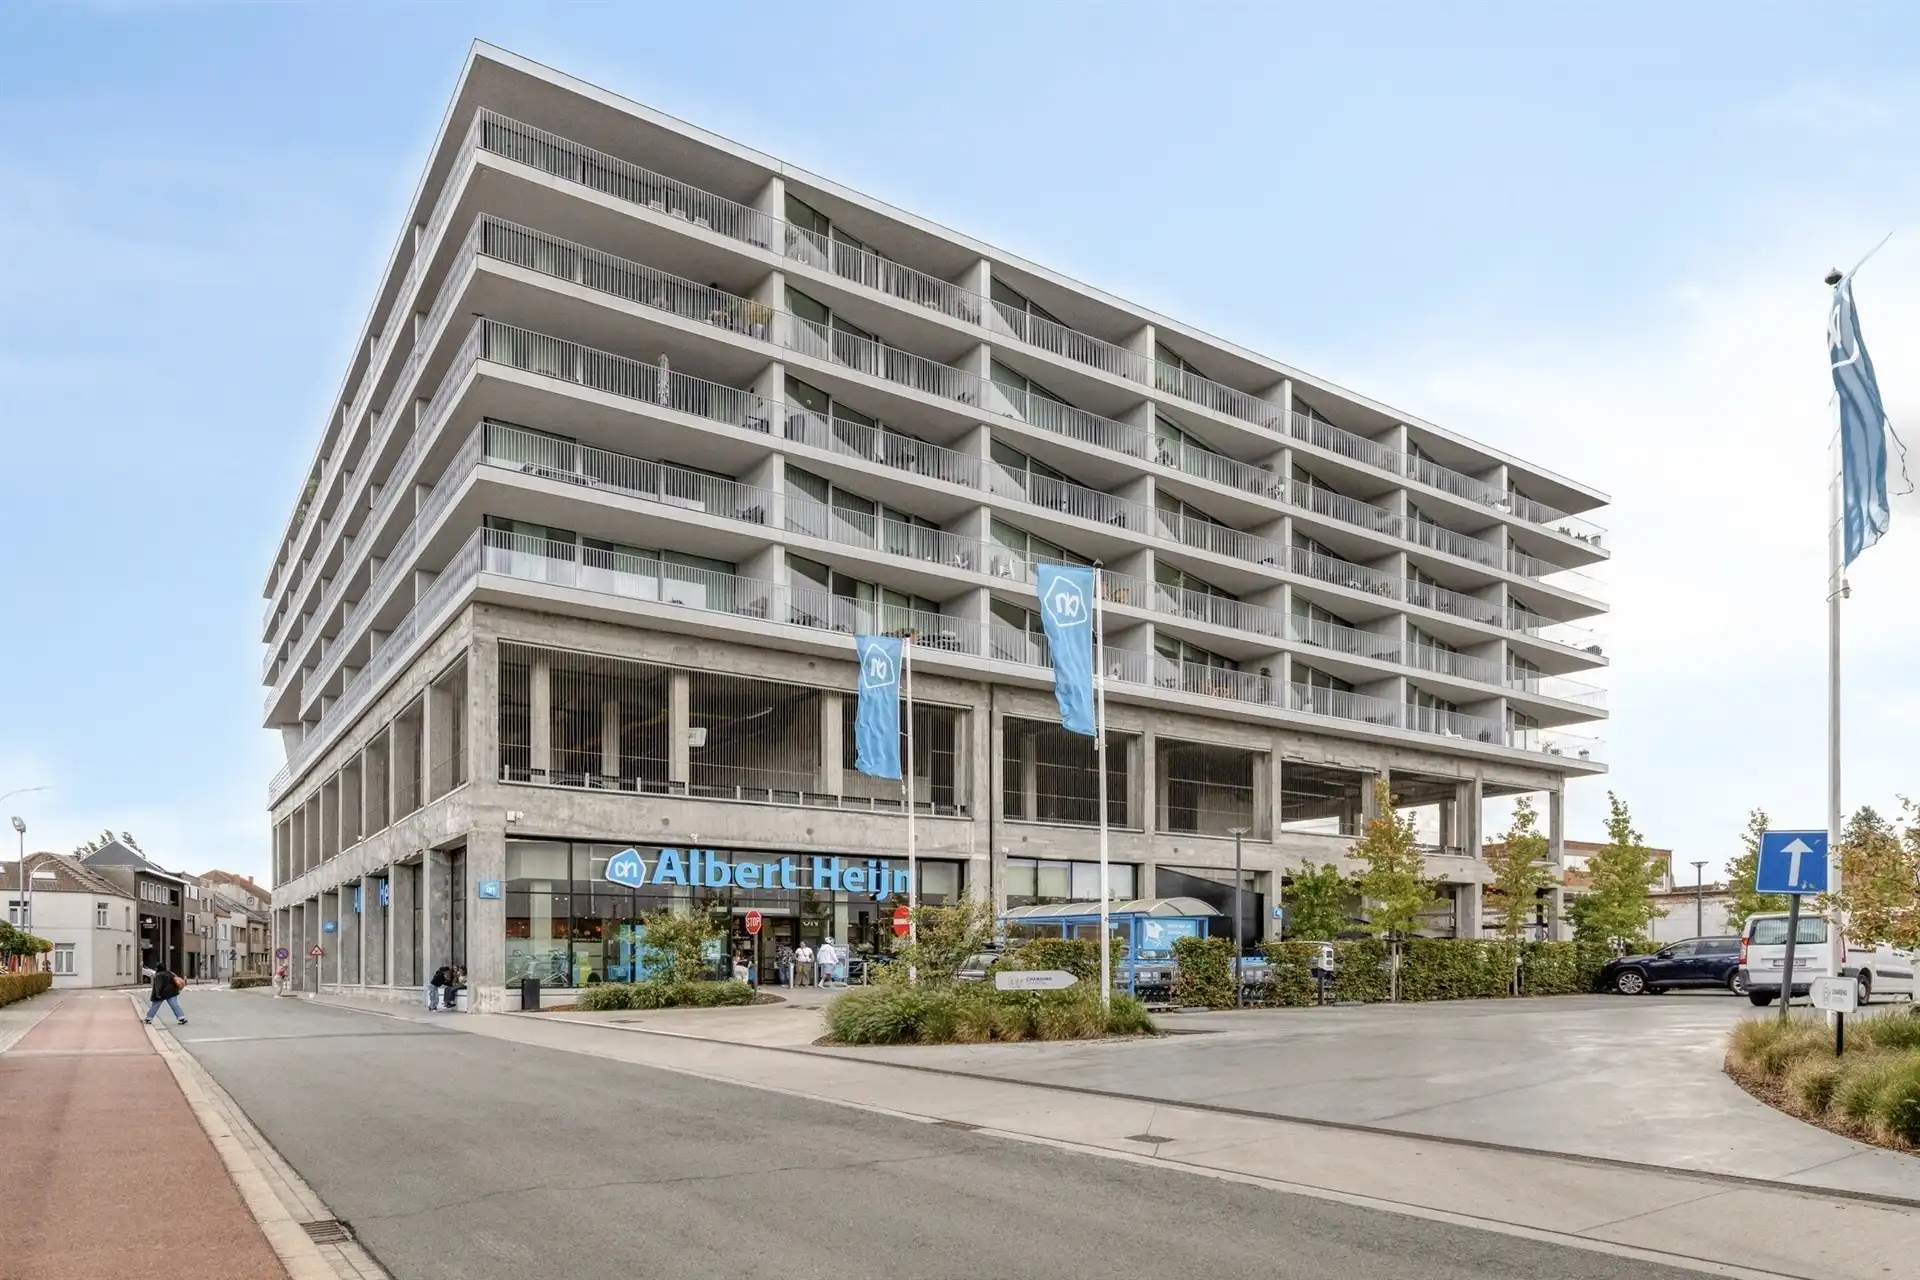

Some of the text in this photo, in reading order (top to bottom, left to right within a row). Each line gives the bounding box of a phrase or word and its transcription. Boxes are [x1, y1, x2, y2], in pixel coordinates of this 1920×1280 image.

[651, 848, 797, 889] Albert
[813, 855, 910, 901] Heijn
[745, 916, 761, 927] STOP
